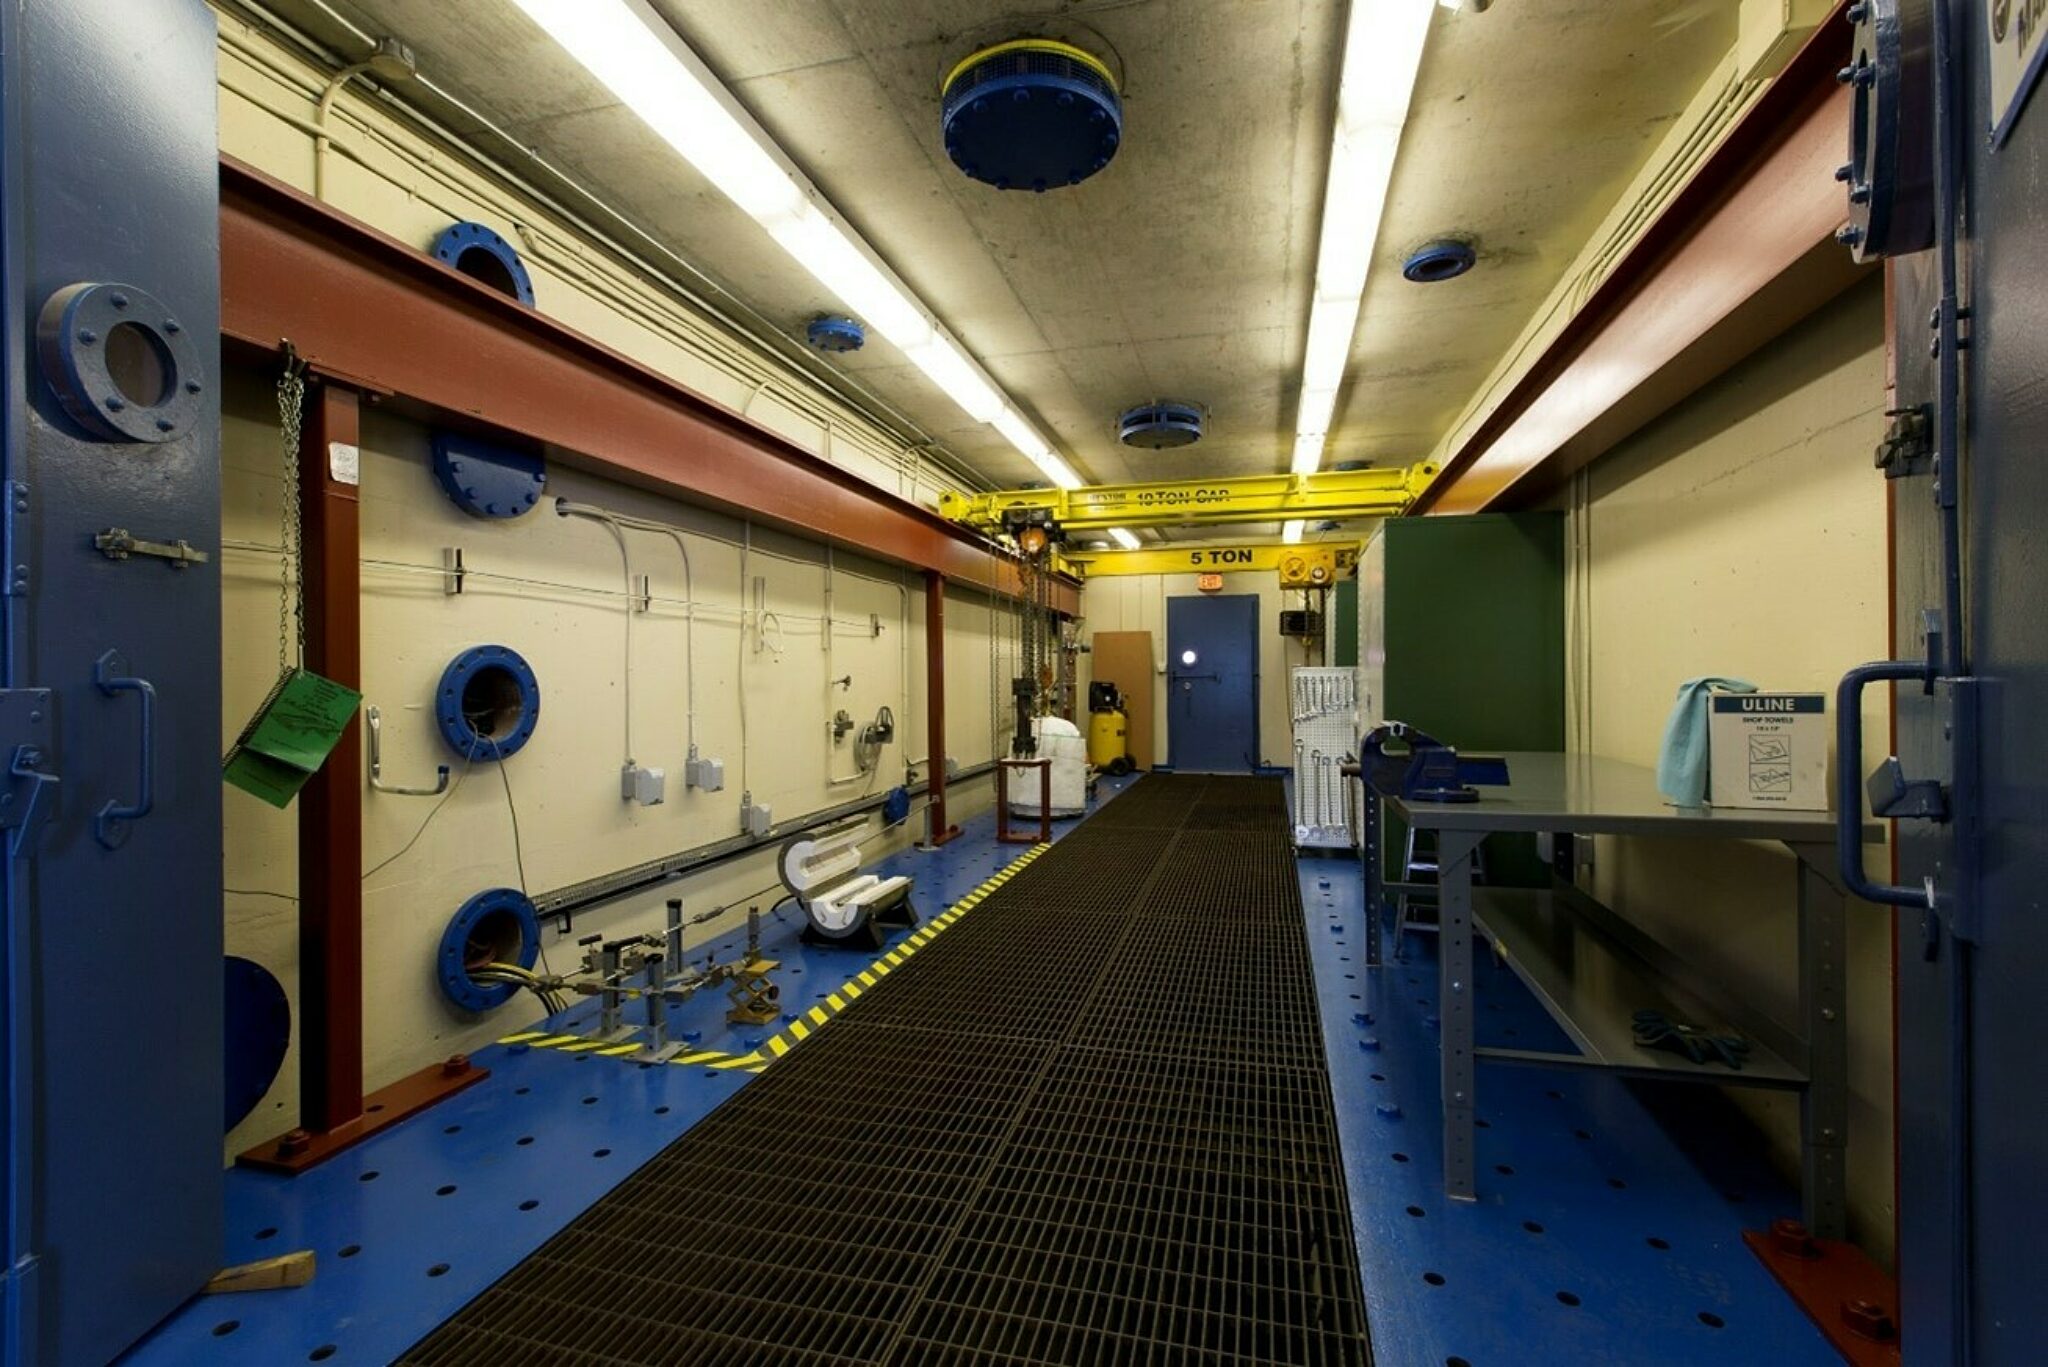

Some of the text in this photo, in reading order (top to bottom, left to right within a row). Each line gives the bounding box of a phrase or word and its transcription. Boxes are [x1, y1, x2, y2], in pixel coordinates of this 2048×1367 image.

[1137, 492, 1153, 506] 10
[1155, 490, 1190, 505] TON
[1191, 549, 1253, 565] 5 TON
[1742, 698, 1795, 711] ULINE
[1742, 716, 1794, 724] SHOP TOWELS
